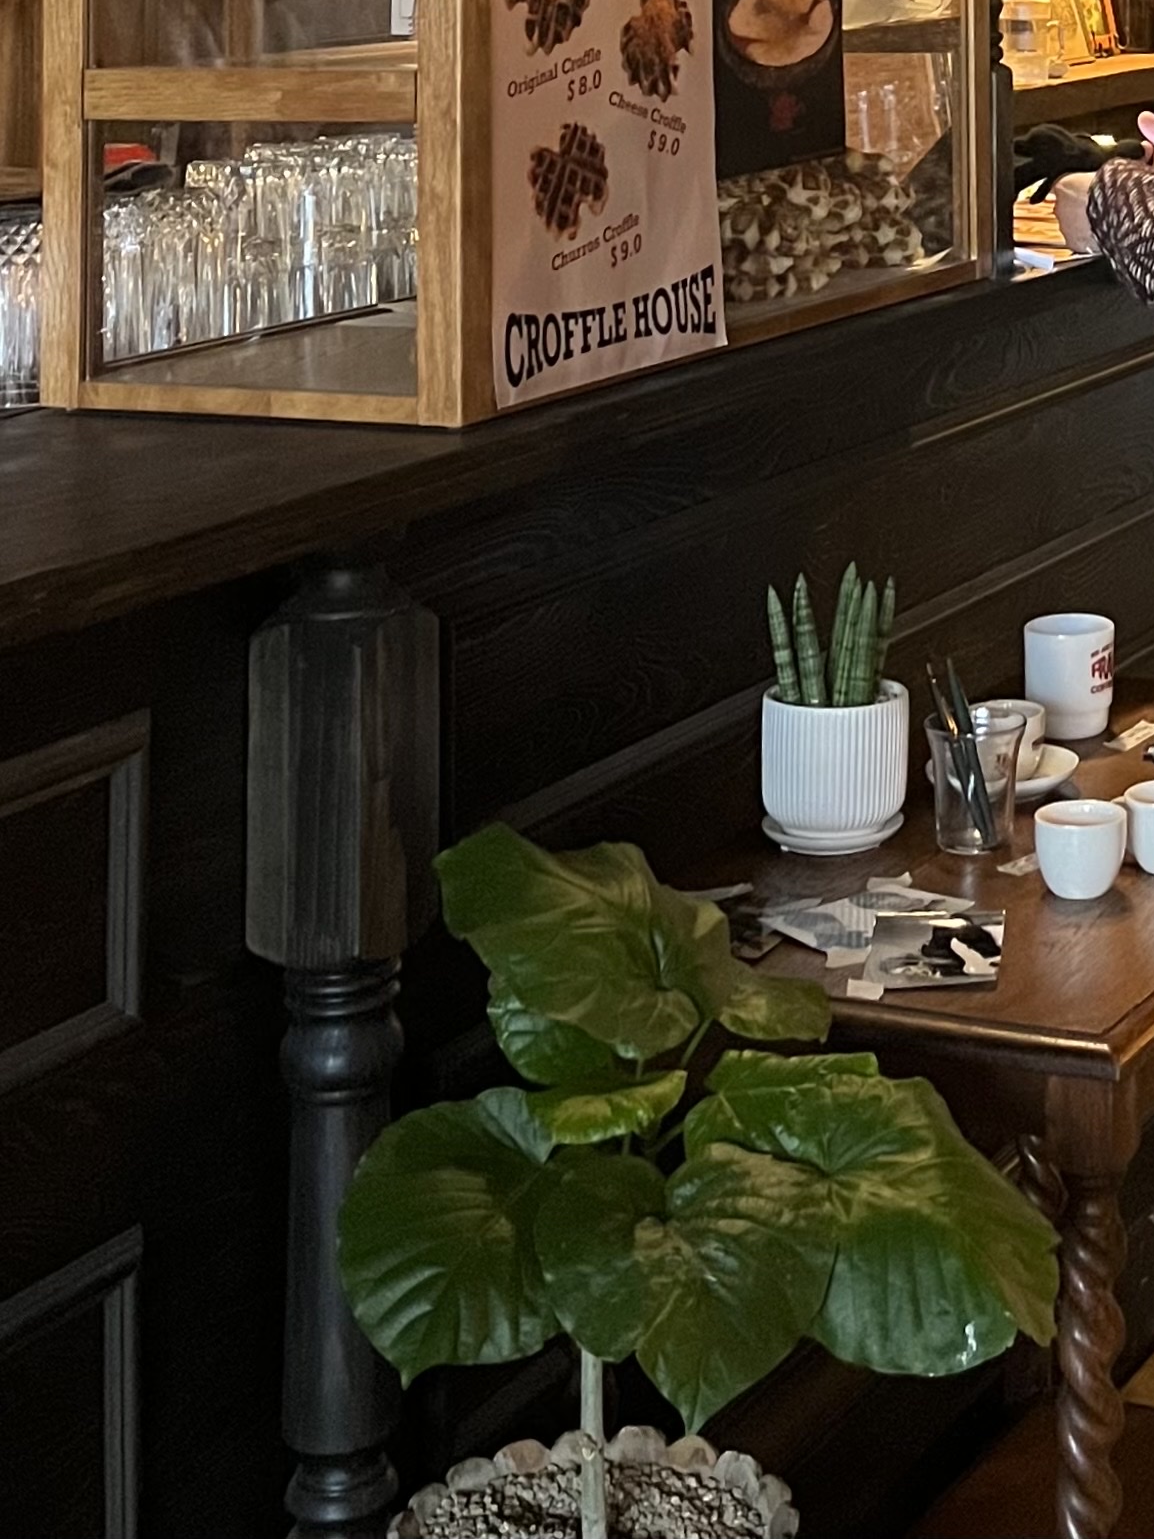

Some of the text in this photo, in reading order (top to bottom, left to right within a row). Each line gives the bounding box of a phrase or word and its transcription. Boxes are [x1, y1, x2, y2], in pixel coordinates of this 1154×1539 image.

[507, 47, 602, 98] Original Croffle
[651, 108, 687, 135] Croffle
[504, 264, 717, 389] CROFFLE HOUSE
